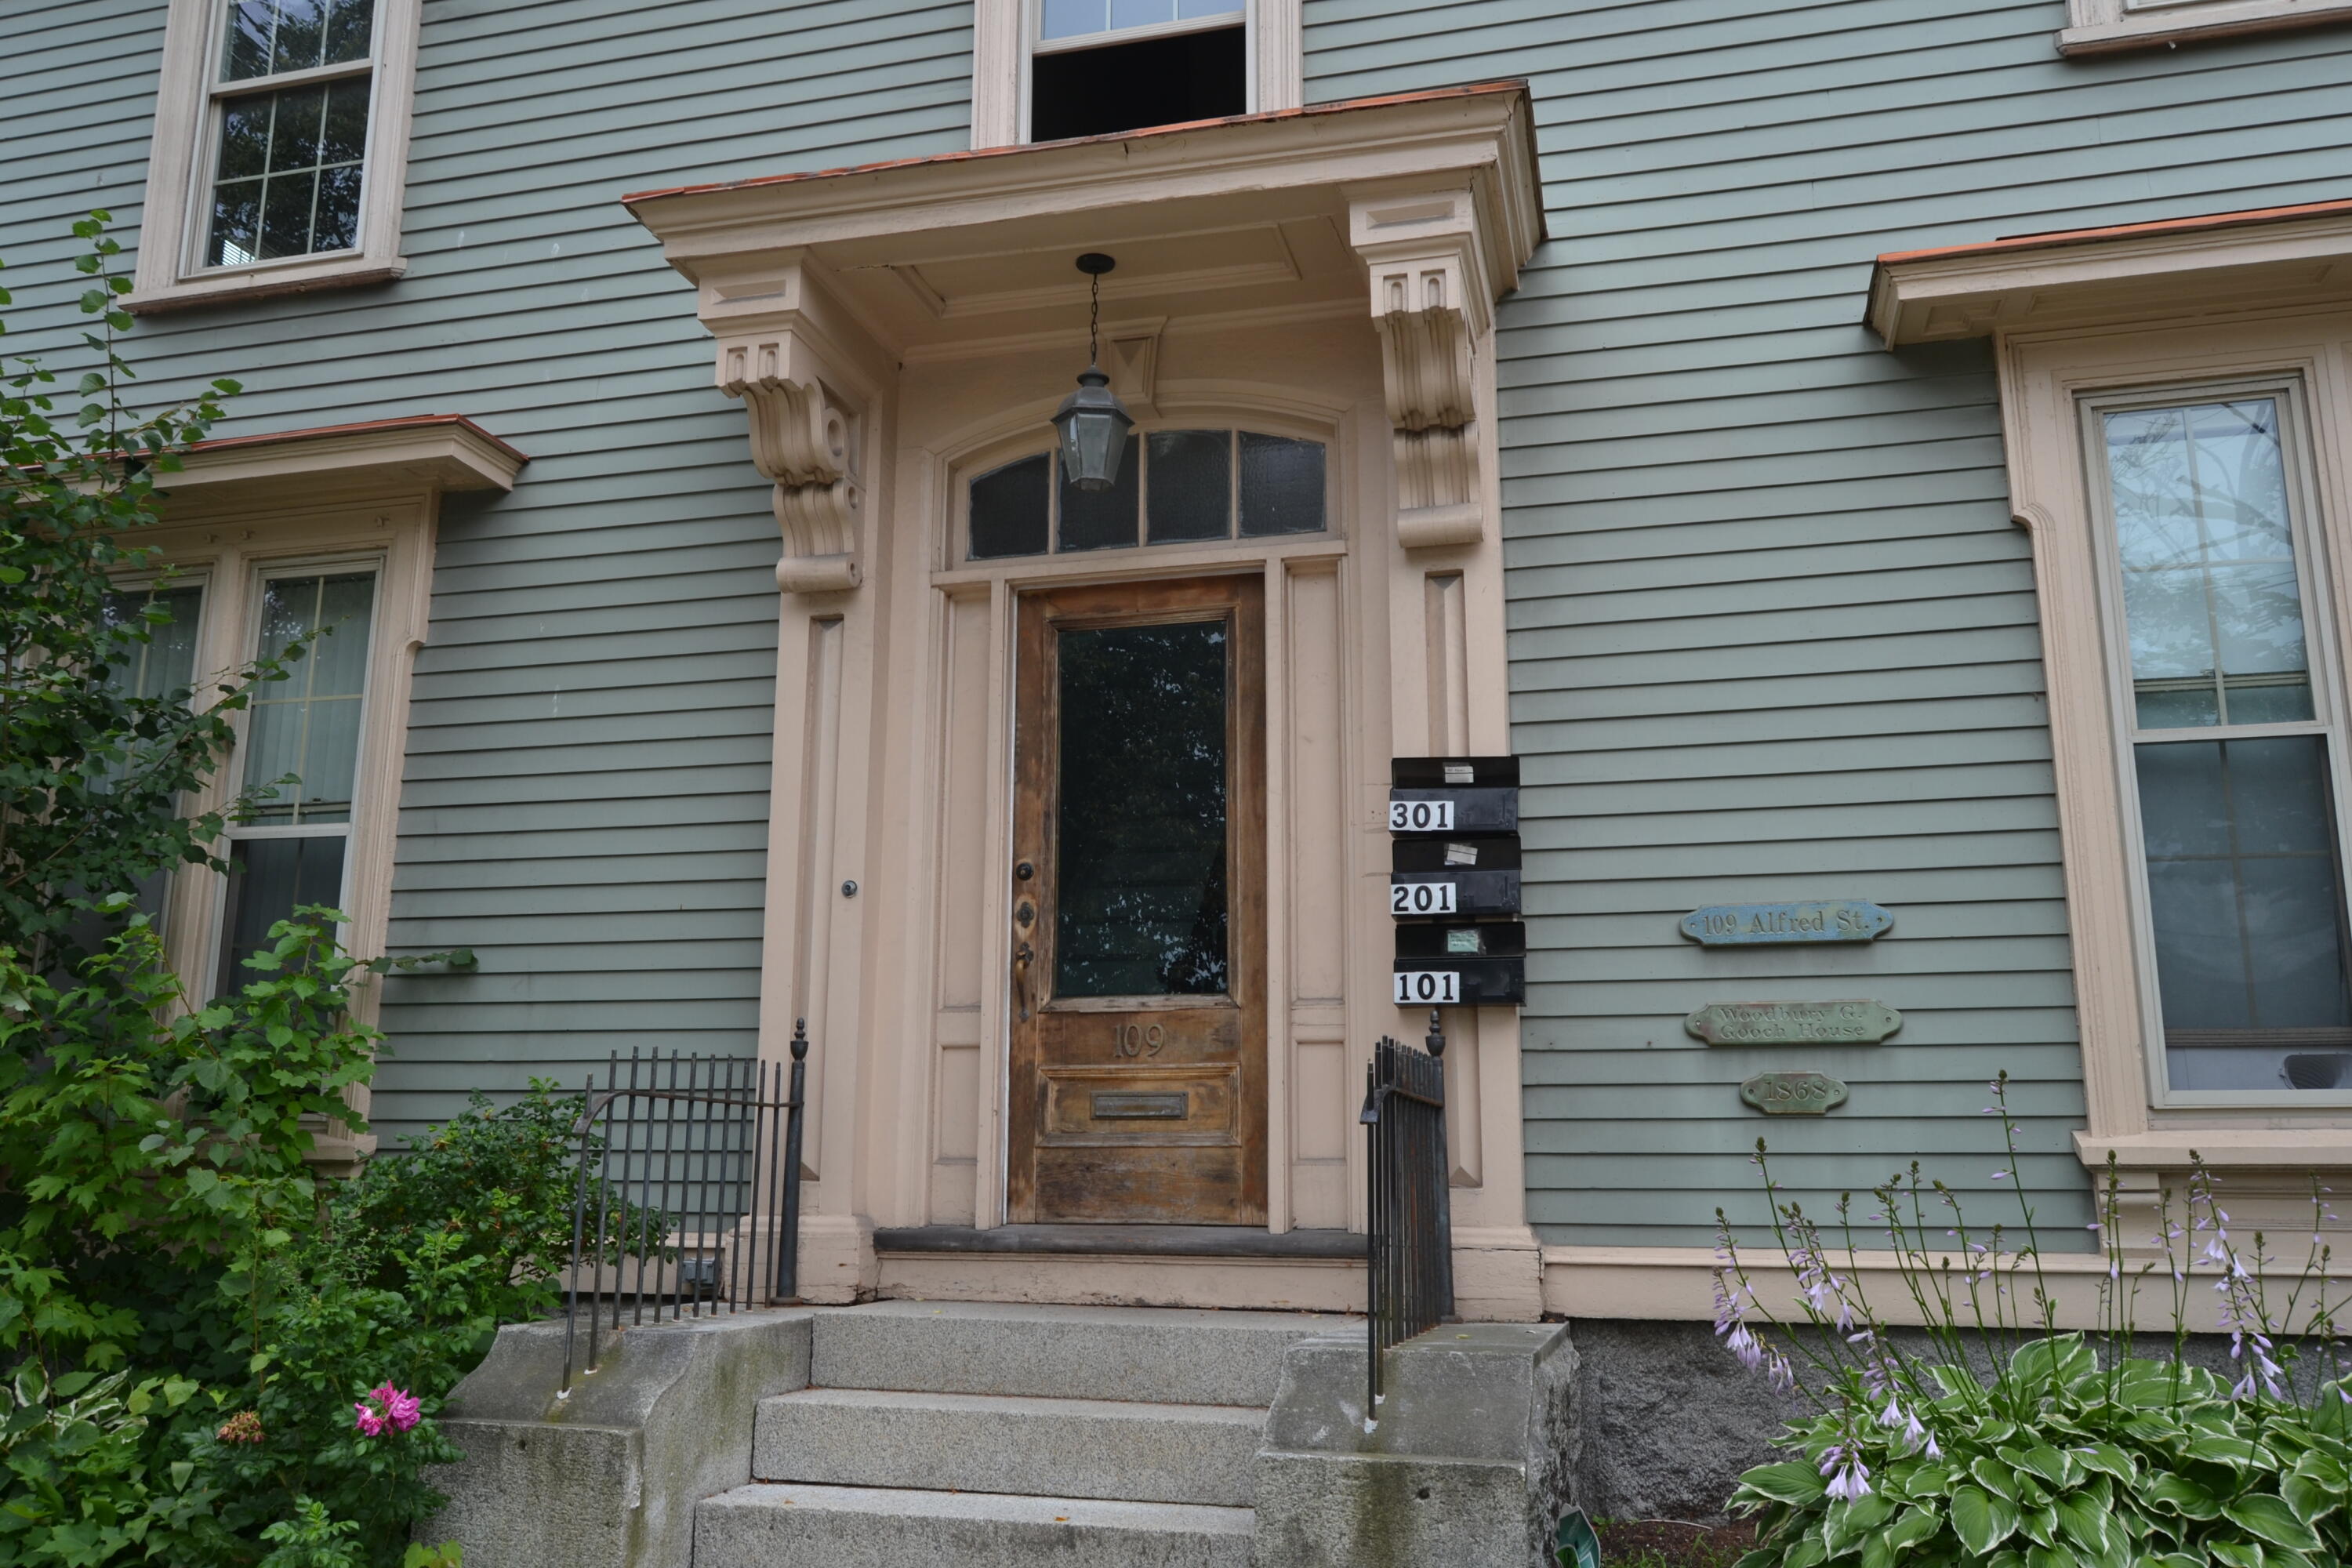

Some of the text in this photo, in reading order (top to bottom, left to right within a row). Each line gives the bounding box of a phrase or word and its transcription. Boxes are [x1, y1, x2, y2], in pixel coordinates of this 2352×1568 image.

[1392, 803, 1448, 828] 301
[1393, 884, 1450, 912] 201
[1703, 909, 1870, 936] 109 Alfred St.
[1399, 973, 1454, 1001] 101
[1719, 1005, 1863, 1024] Woodbury G.
[1114, 1023, 1164, 1058] 109
[1719, 1022, 1865, 1040] Gooch House
[1764, 1080, 1828, 1102] 1868
